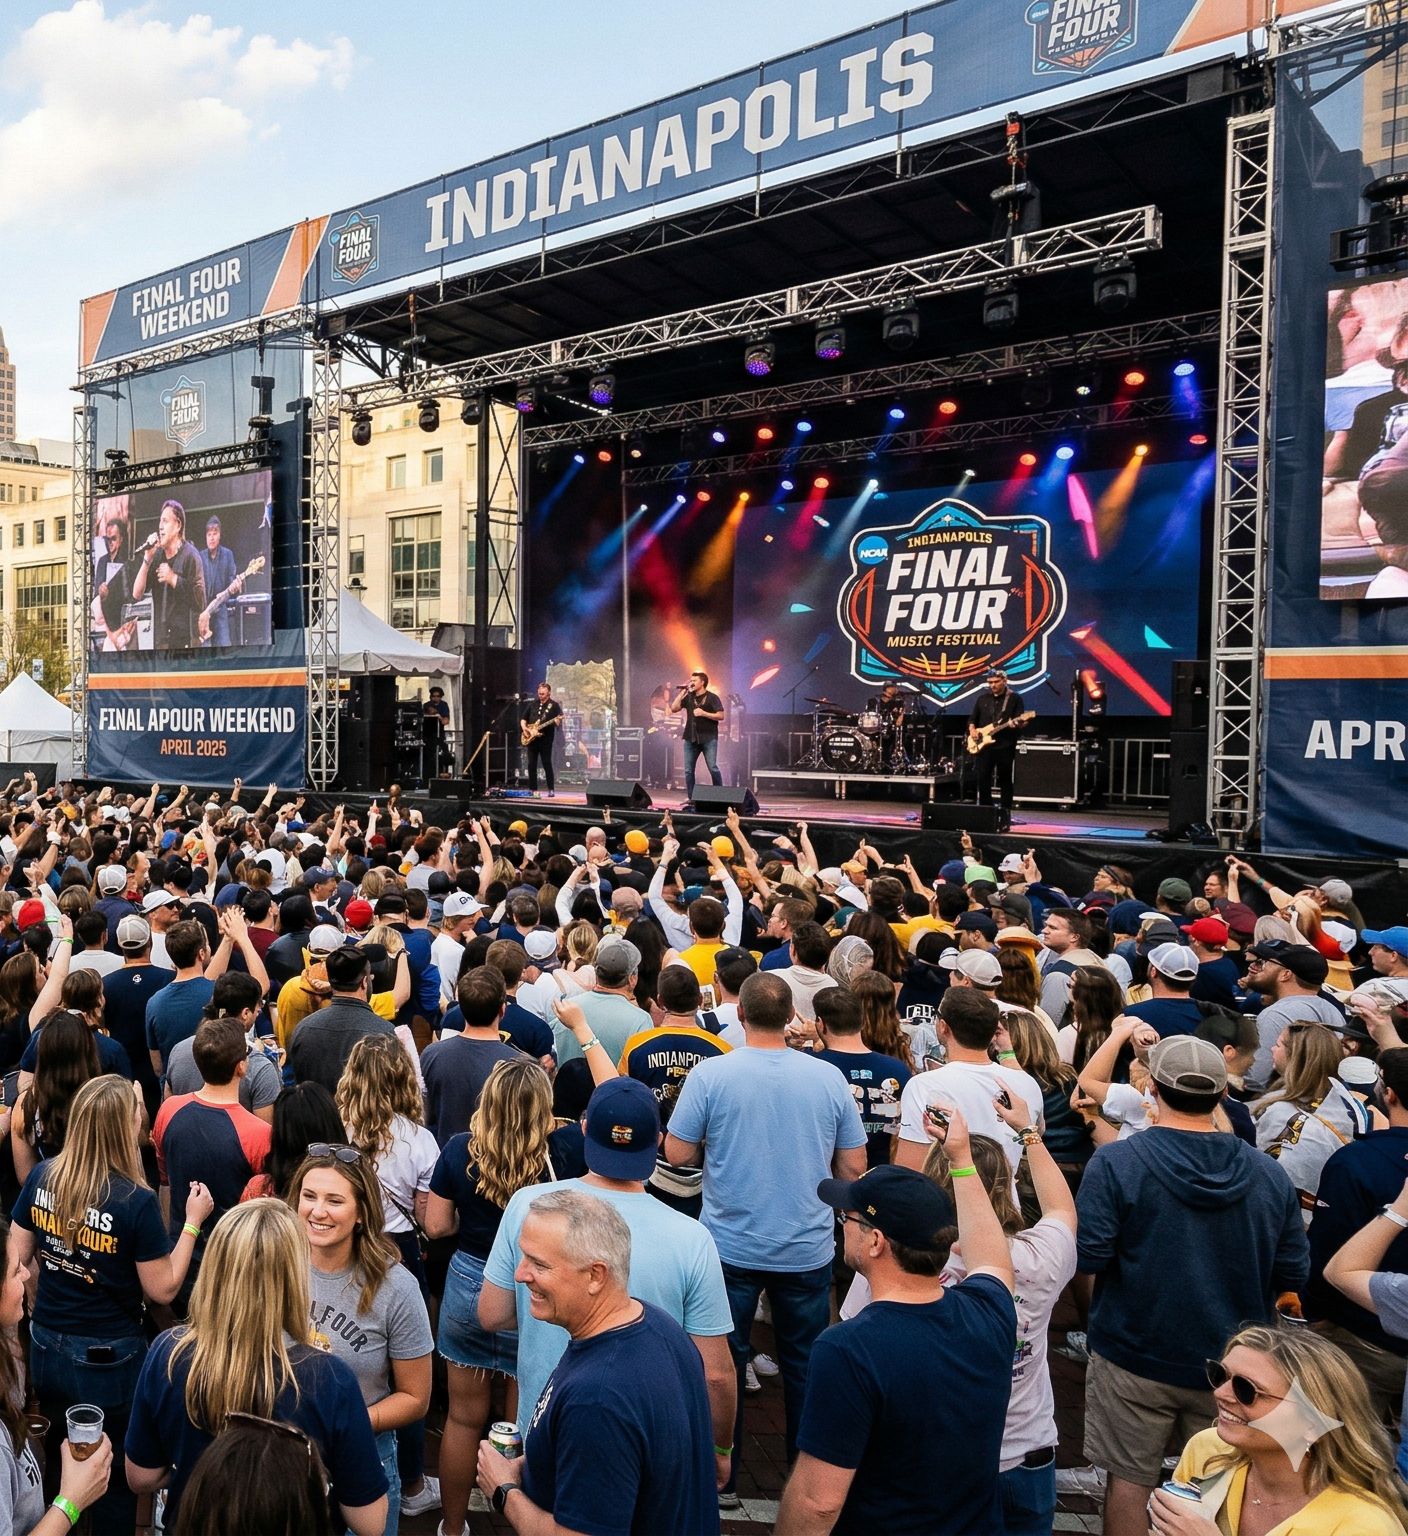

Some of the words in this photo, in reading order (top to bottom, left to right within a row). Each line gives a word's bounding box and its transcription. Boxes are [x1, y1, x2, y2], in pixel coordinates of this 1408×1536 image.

[1047, 4, 1121, 48] FOUR
[1050, 0, 1119, 24] FIN
[424, 31, 935, 253] INDIANAPOLIS
[338, 241, 371, 265] FOUR
[339, 226, 372, 249] FINAL
[132, 277, 185, 317] FINAL
[189, 257, 242, 299] FOUR
[140, 290, 230, 341] WEEKEND
[907, 531, 993, 548] INDIANAPOLIS
[886, 545, 1012, 591] FINAL
[883, 589, 1010, 632] FOUR
[887, 636, 933, 648] MUSIC
[935, 633, 1002, 647] FESTIVAL
[99, 707, 145, 731] FINAL
[147, 707, 205, 732] APOUR
[209, 706, 296, 733] WEEKEND
[1304, 719, 1407, 761] APR
[160, 738, 195, 756] APRIL
[196, 739, 227, 757] 2025
[320, 1304, 368, 1353] FOUR
